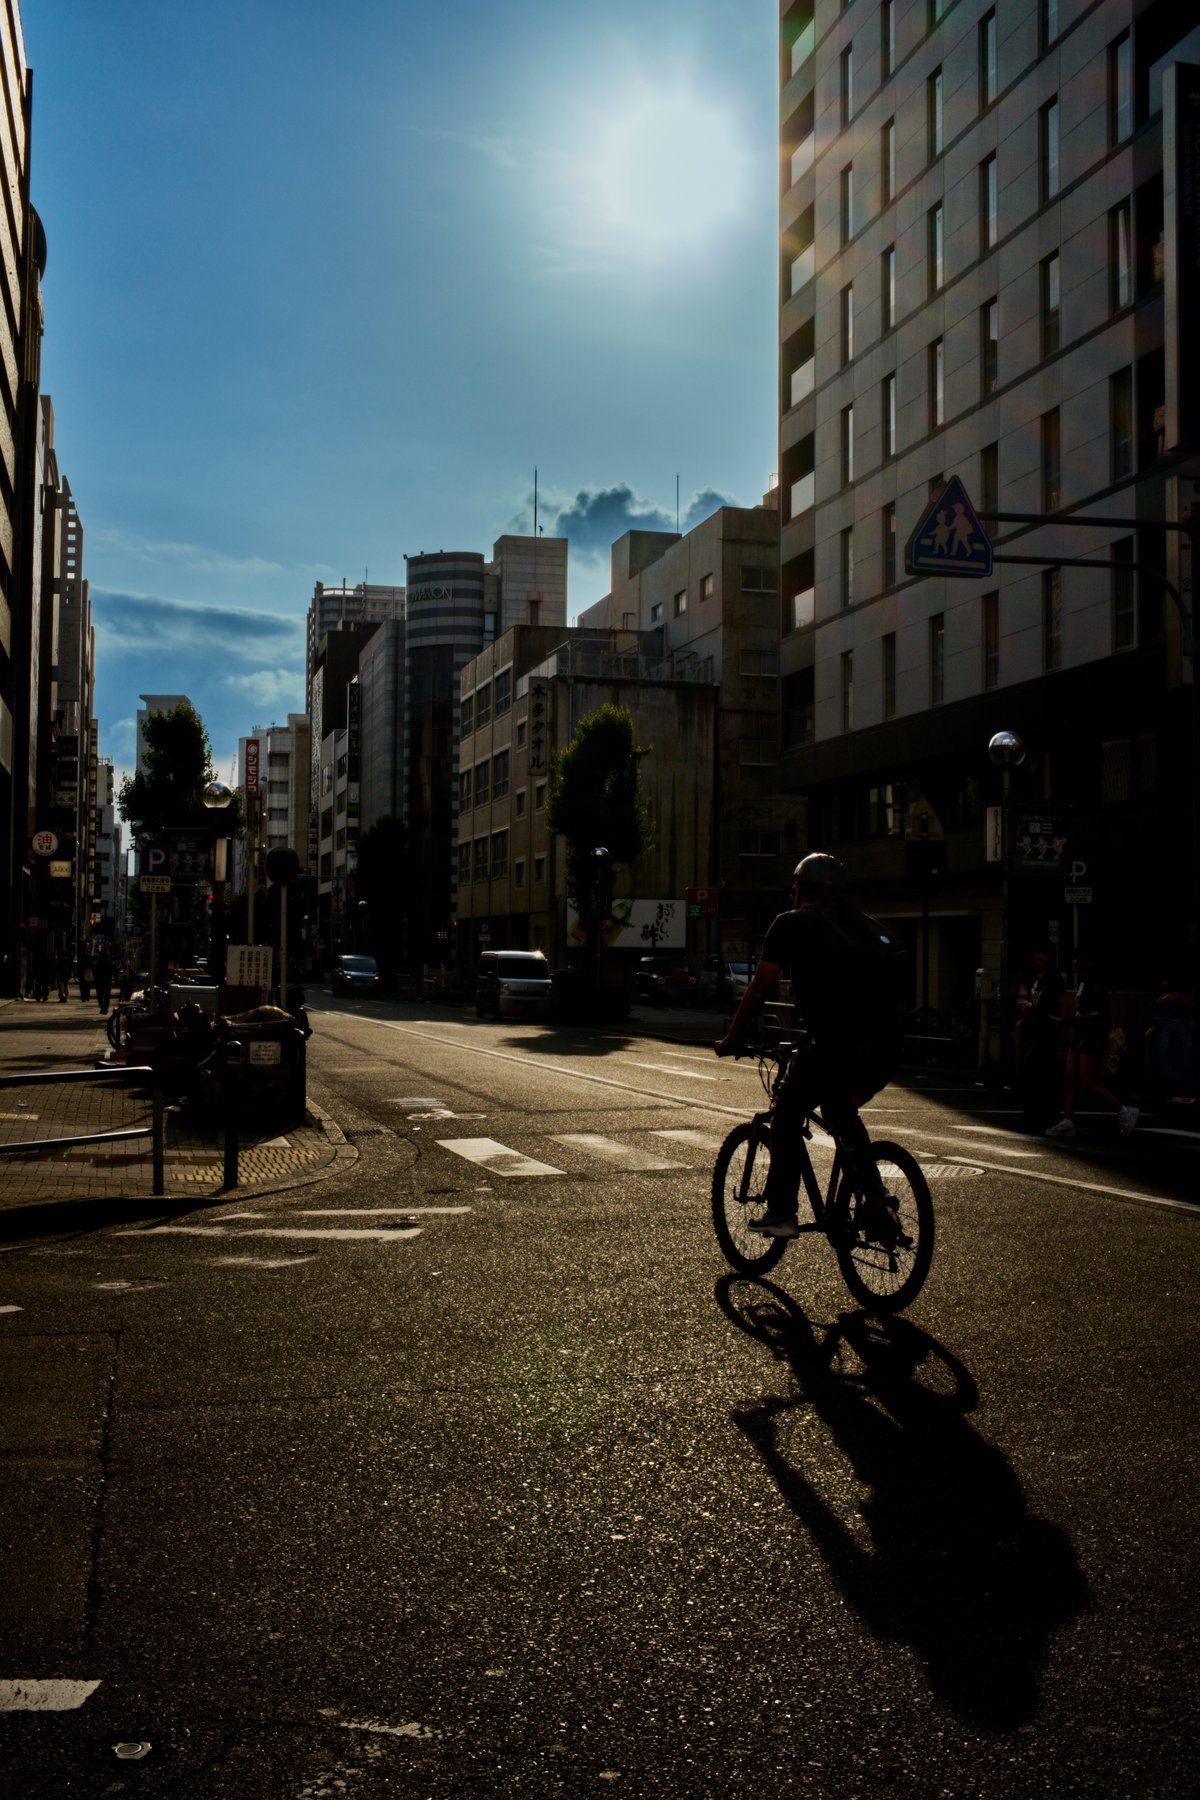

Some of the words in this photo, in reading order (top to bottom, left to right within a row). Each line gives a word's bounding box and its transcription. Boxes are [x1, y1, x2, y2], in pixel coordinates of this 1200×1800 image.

[530, 683, 546, 769] 本多タオル
[149, 848, 166, 872] P
[1071, 860, 1087, 884] P
[696, 890, 708, 903] P
[133, 926, 141, 936] P
[481, 924, 489, 933] P
